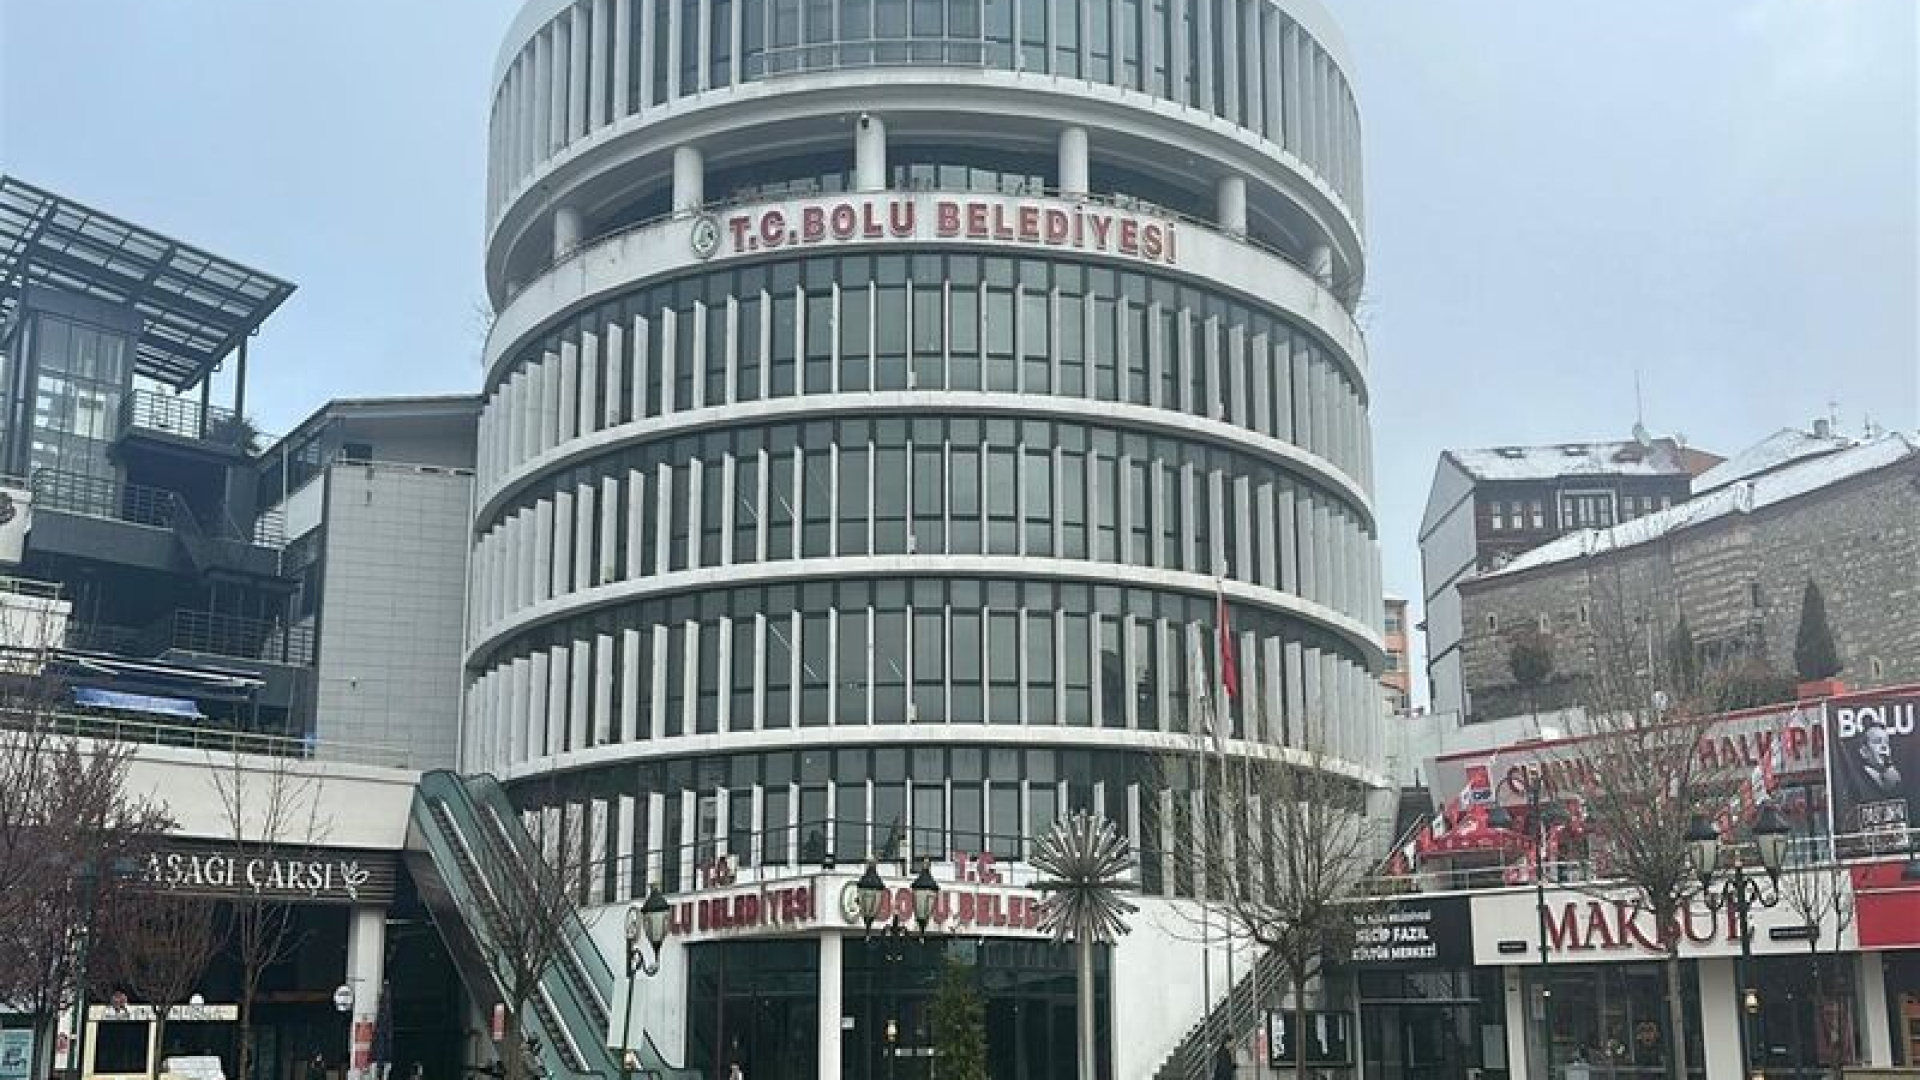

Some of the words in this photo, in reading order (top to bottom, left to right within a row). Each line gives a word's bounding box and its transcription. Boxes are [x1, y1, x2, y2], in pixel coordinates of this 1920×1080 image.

[937, 201, 1177, 264] BELEDİYESİ
[1838, 703, 1914, 738] BOLU
[143, 852, 235, 890] AŞAĞI
[246, 858, 332, 896] ÇARŞI
[876, 886, 949, 925] BOU
